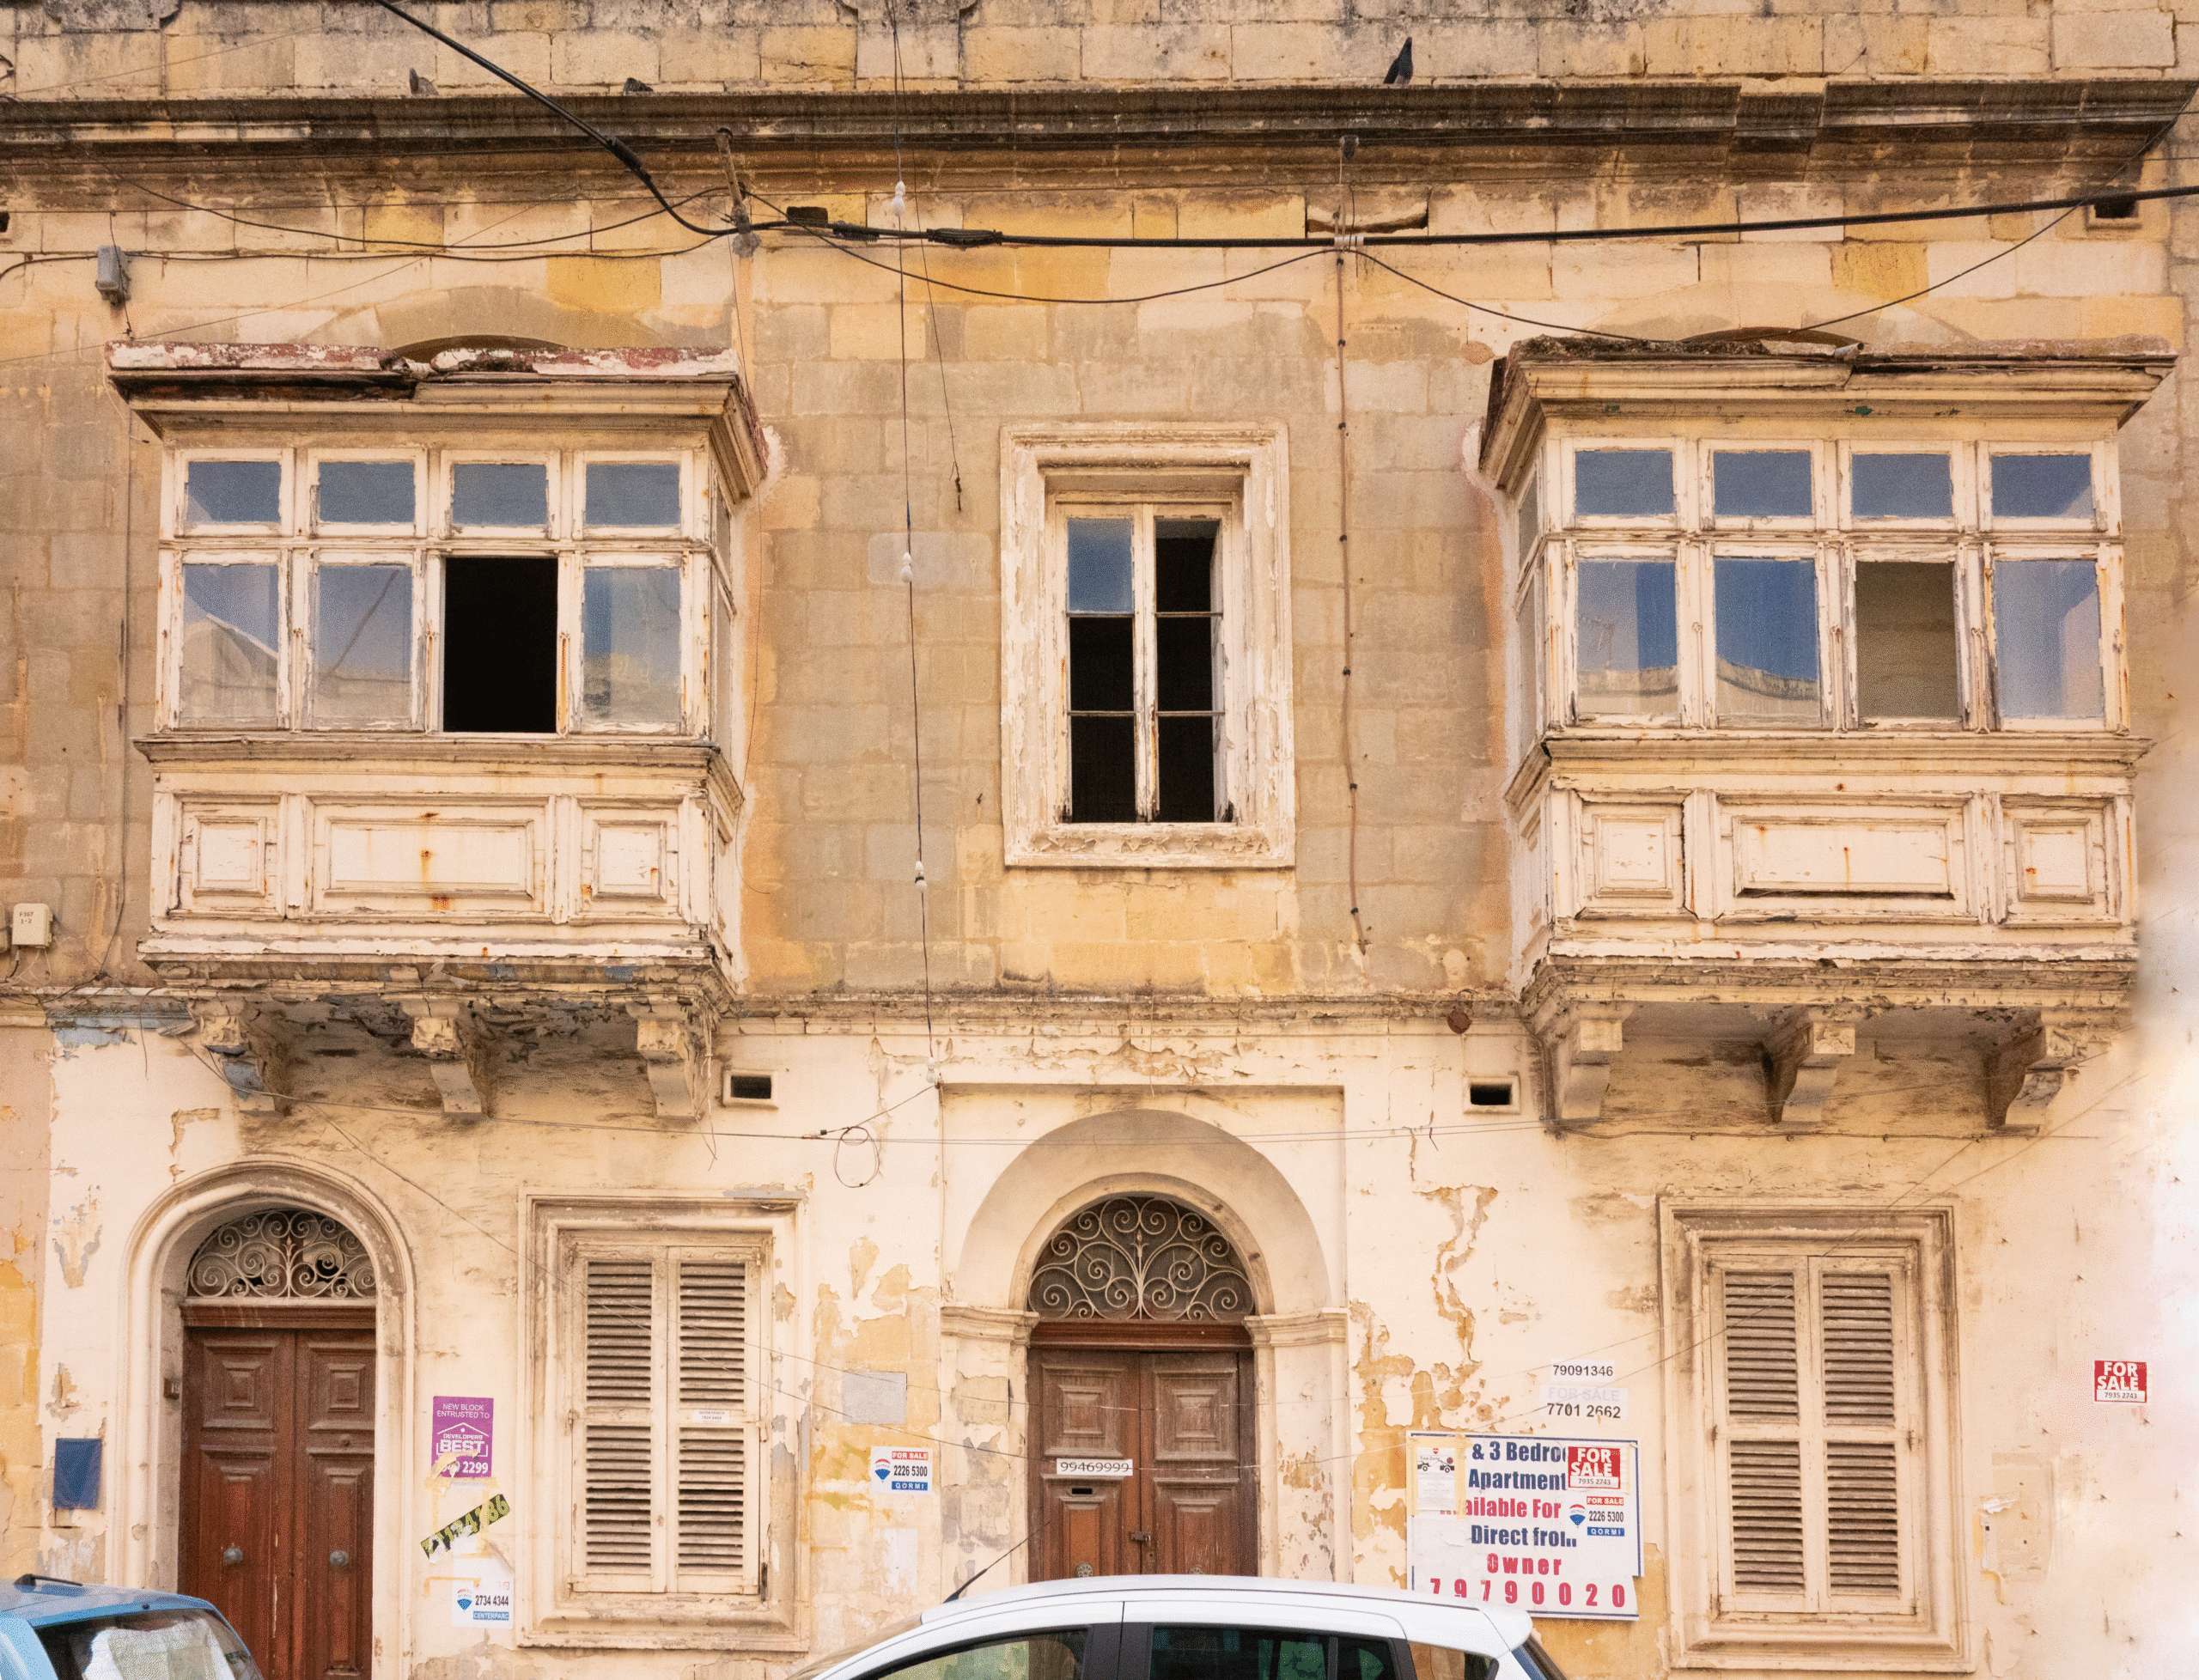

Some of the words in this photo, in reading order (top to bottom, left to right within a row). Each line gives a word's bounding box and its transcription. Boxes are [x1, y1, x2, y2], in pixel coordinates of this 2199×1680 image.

[1553, 1365, 1613, 1376] 79091346
[2104, 1361, 2138, 1377] FOR
[2097, 1376, 2139, 1391] SALE
[1548, 1386, 1577, 1399] FOR
[1582, 1388, 1619, 1402] SALE
[1547, 1403, 1580, 1416] 7701
[1587, 1404, 1621, 1419] 2662
[440, 1439, 484, 1454] BEST
[1471, 1443, 1484, 1460] &
[1489, 1440, 1501, 1461] 3
[1577, 1447, 1611, 1463] FOR
[462, 1461, 489, 1474] 2299
[893, 1465, 910, 1476] 2226
[911, 1465, 928, 1477] 5300
[1060, 1462, 1129, 1472] 99469999
[1570, 1462, 1612, 1476] SALE
[1532, 1499, 1562, 1519] For
[1589, 1511, 1605, 1522] 2226
[1607, 1512, 1623, 1522] 5300
[1471, 1525, 1528, 1546] Direct
[1486, 1553, 1562, 1575] Owner
[475, 1595, 491, 1605] 2734
[493, 1595, 509, 1606] 4344
